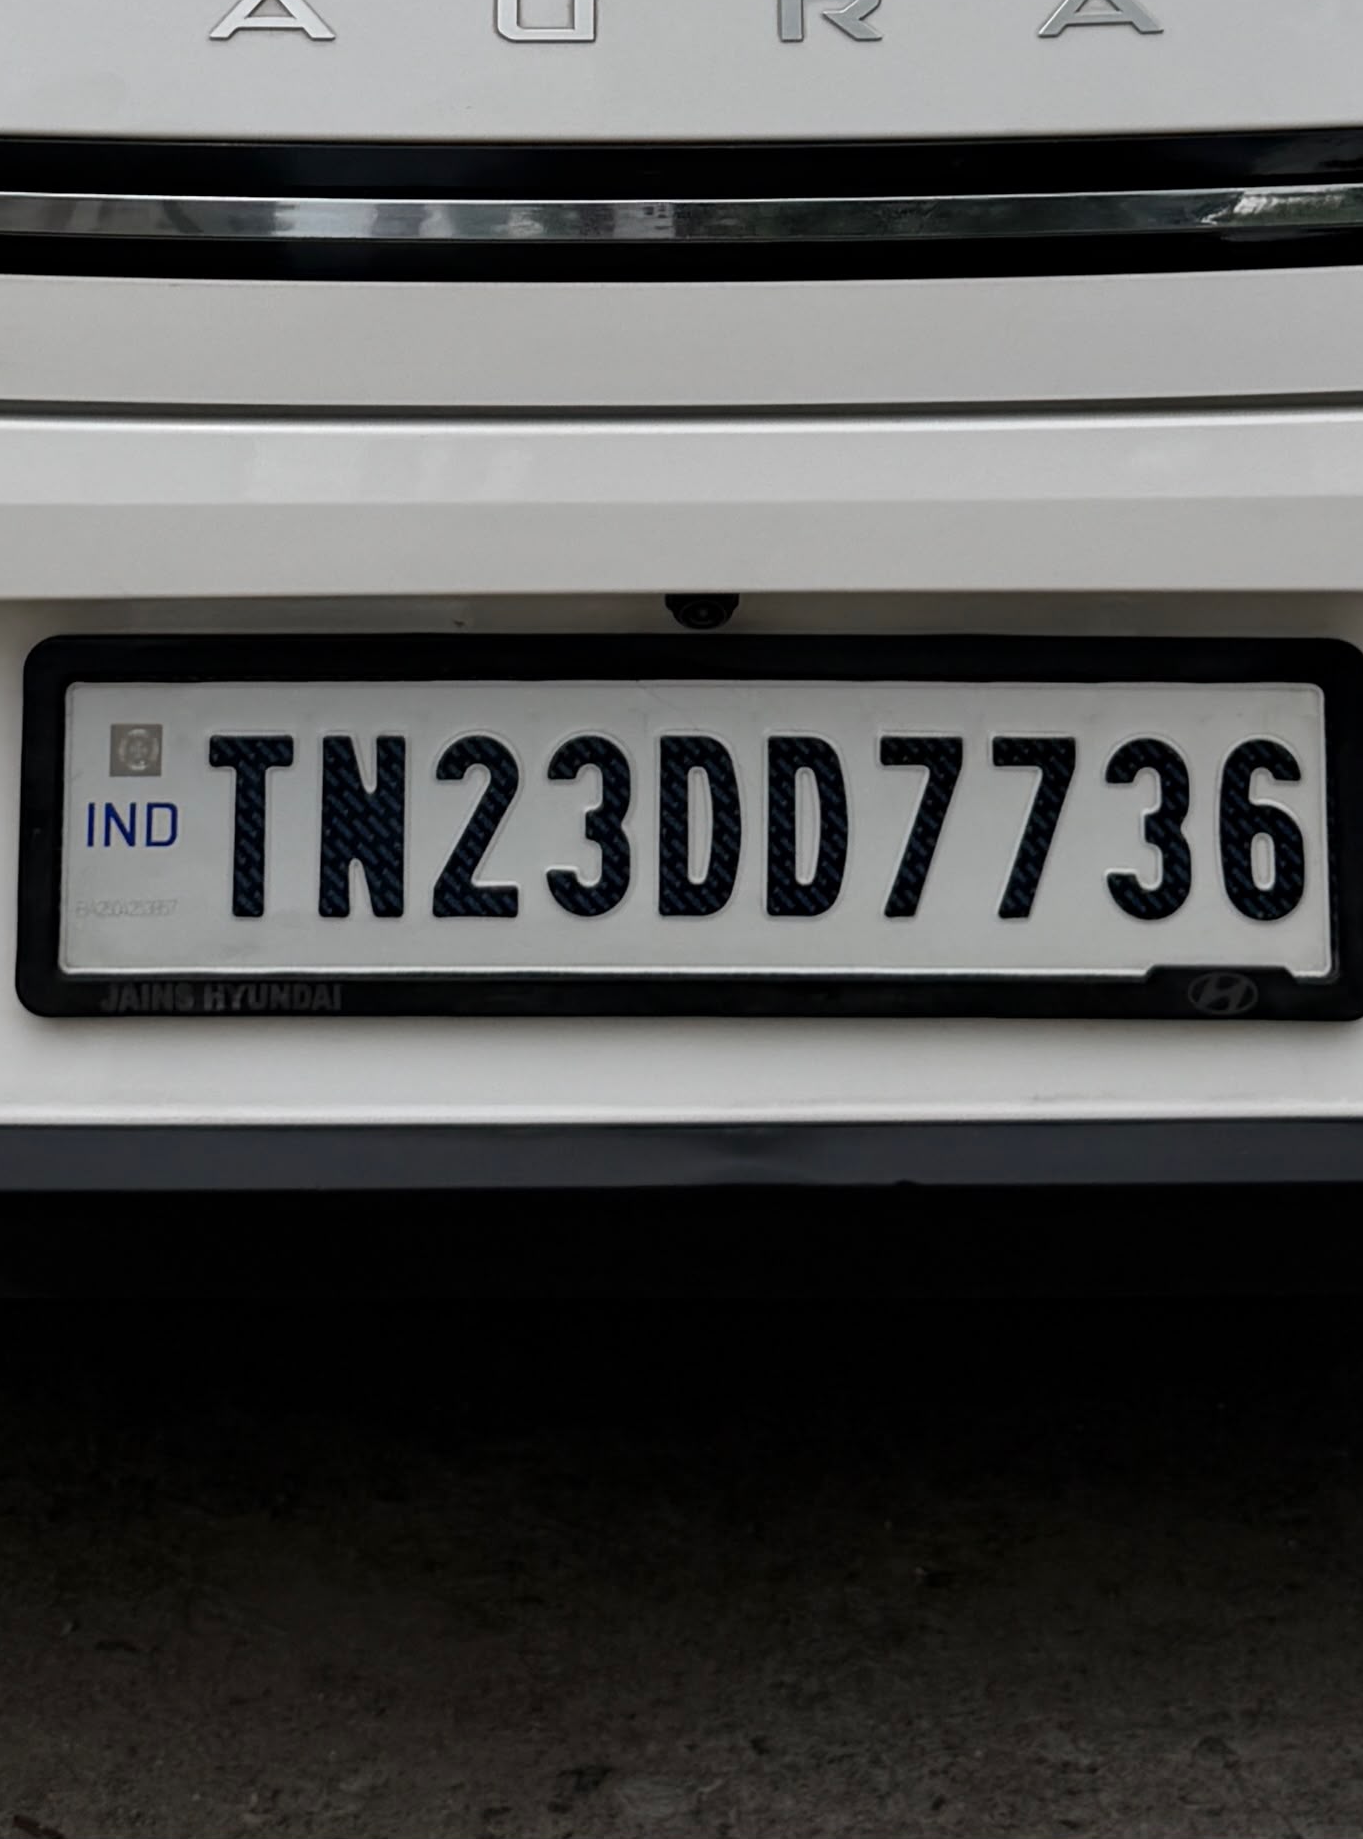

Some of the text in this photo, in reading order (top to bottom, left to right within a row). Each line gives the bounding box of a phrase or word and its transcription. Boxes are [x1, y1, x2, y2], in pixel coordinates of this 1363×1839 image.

[86, 802, 179, 848] IND
[208, 734, 1307, 921] TN23DD7736
[100, 983, 342, 1012] JAINS HYUNDAI
